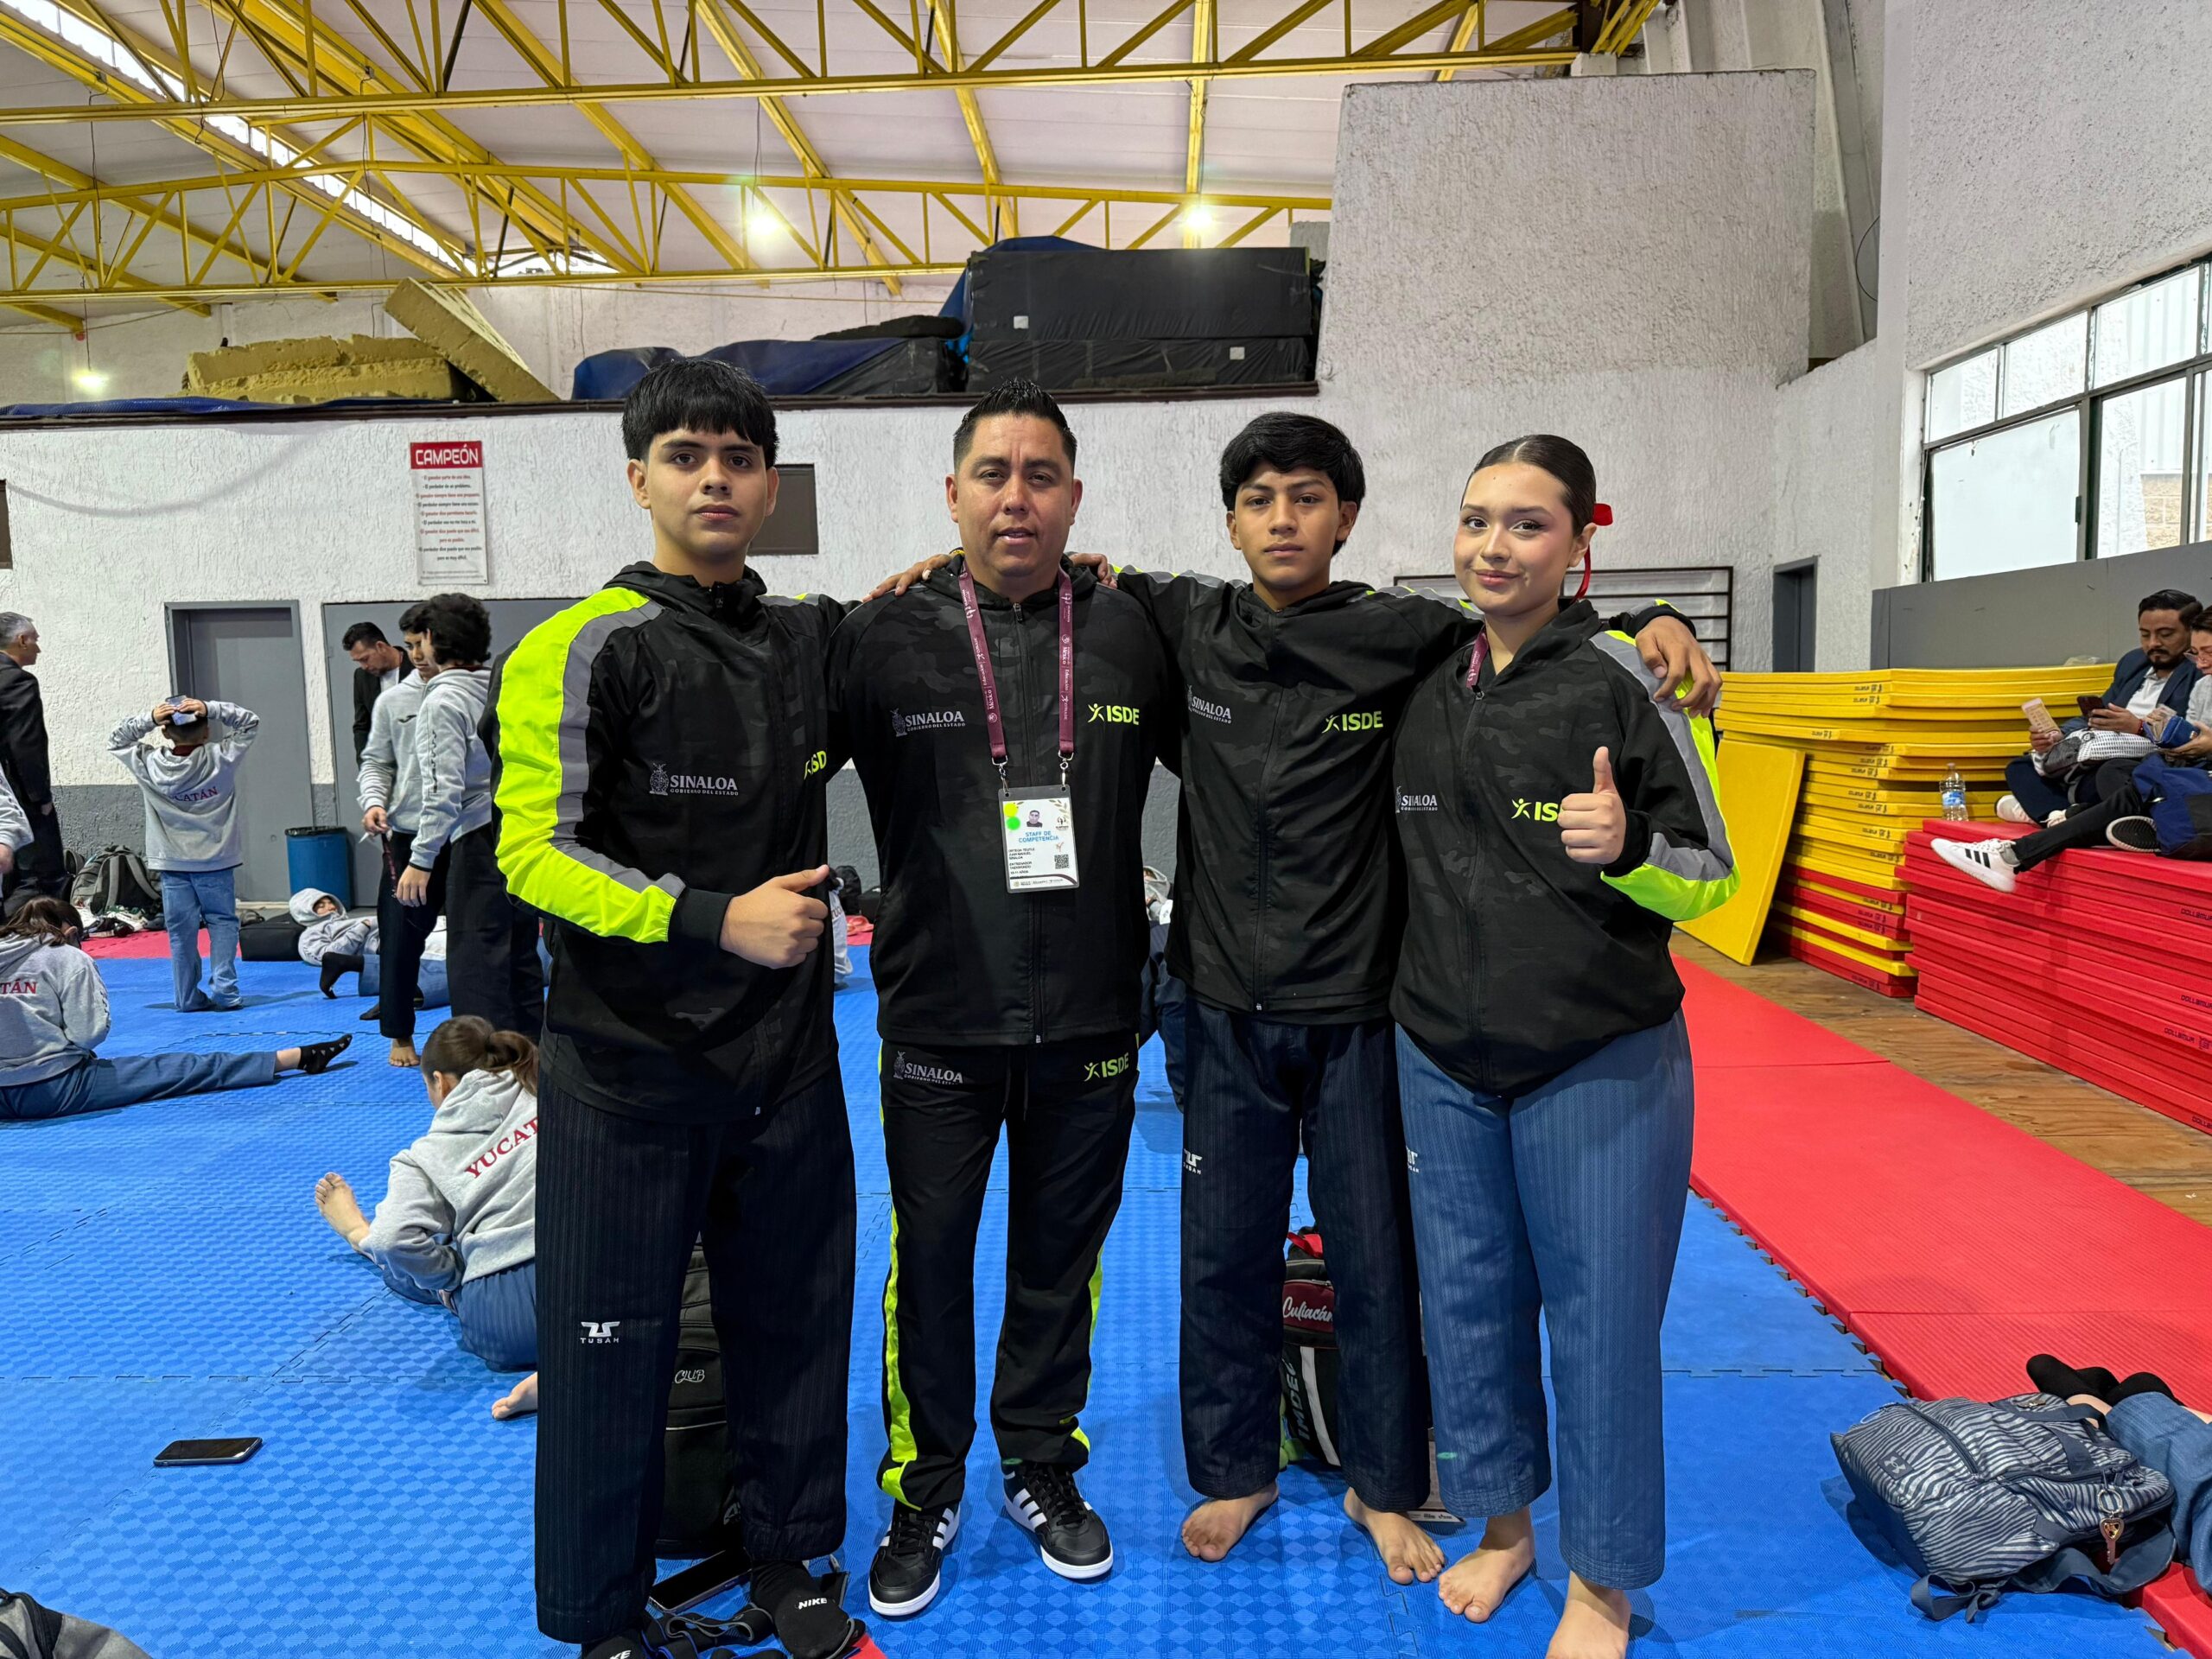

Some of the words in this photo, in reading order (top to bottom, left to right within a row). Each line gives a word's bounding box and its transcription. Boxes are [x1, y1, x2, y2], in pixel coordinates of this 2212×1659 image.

[416, 443, 479, 465] CAMPEÓN
[1106, 705, 1140, 725] ISDE
[1192, 696, 1232, 720] SINALOA
[905, 710, 965, 728] SINALOA
[1342, 710, 1383, 731] ISDE
[670, 774, 738, 791] SINALOA
[170, 785, 219, 802] CATÁN
[1535, 801, 1562, 822] IS
[0, 978, 37, 995] TÁN
[905, 1063, 963, 1084] SINALOA
[1101, 1052, 1129, 1077] ISDE
[1282, 1296, 1333, 1322] Culiacán
[798, 1598, 828, 1610] NIKE
